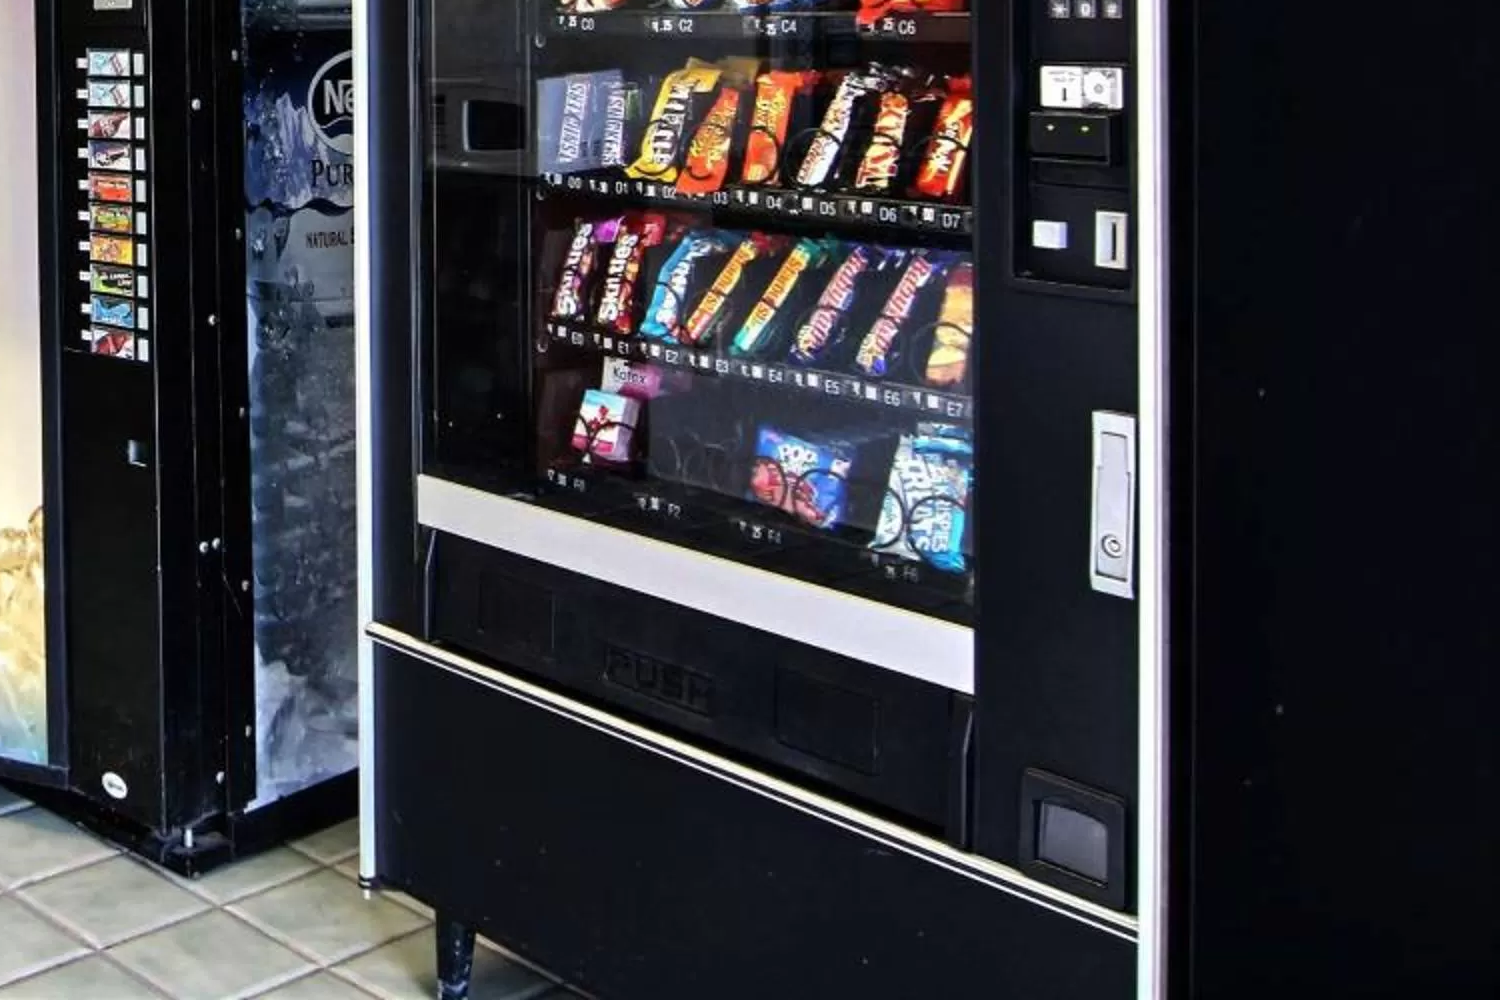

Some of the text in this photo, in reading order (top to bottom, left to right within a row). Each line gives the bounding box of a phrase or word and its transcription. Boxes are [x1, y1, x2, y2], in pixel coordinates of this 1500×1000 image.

[679, 20, 693, 33] C2
[781, 19, 797, 33] C4
[898, 19, 916, 35] C6
[820, 201, 837, 216] D5
[880, 208, 897, 223] D6
[943, 213, 960, 228] D7
[824, 379, 840, 394] E5
[884, 390, 900, 406] E6
[947, 401, 963, 417] E7
